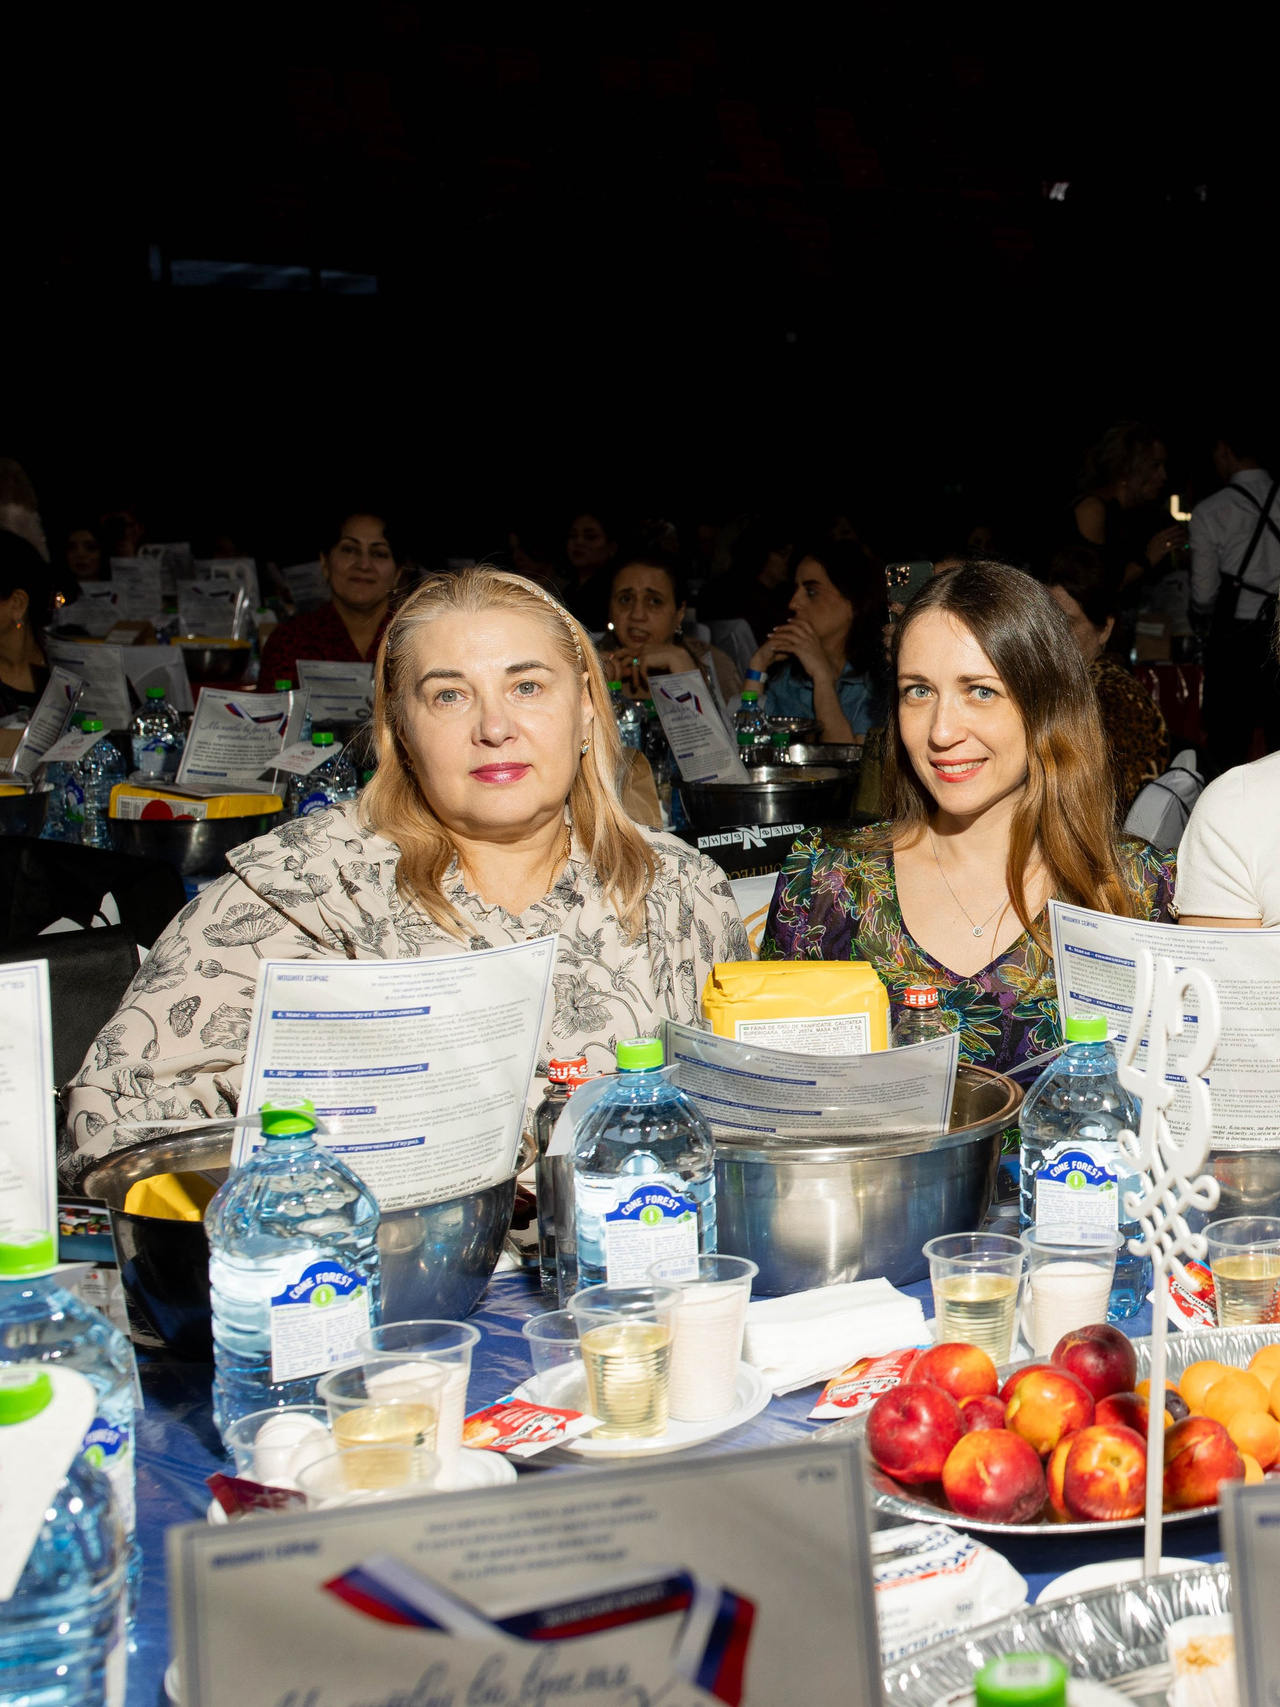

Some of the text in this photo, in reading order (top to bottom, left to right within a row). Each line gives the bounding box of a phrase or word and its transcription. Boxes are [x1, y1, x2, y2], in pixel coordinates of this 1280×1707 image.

[698, 831, 743, 849] БАНК
[1049, 1160, 1103, 1179] CONE FOREST
[621, 1194, 681, 1216] CONE FOREST
[289, 1272, 354, 1299] CONE FOREST
